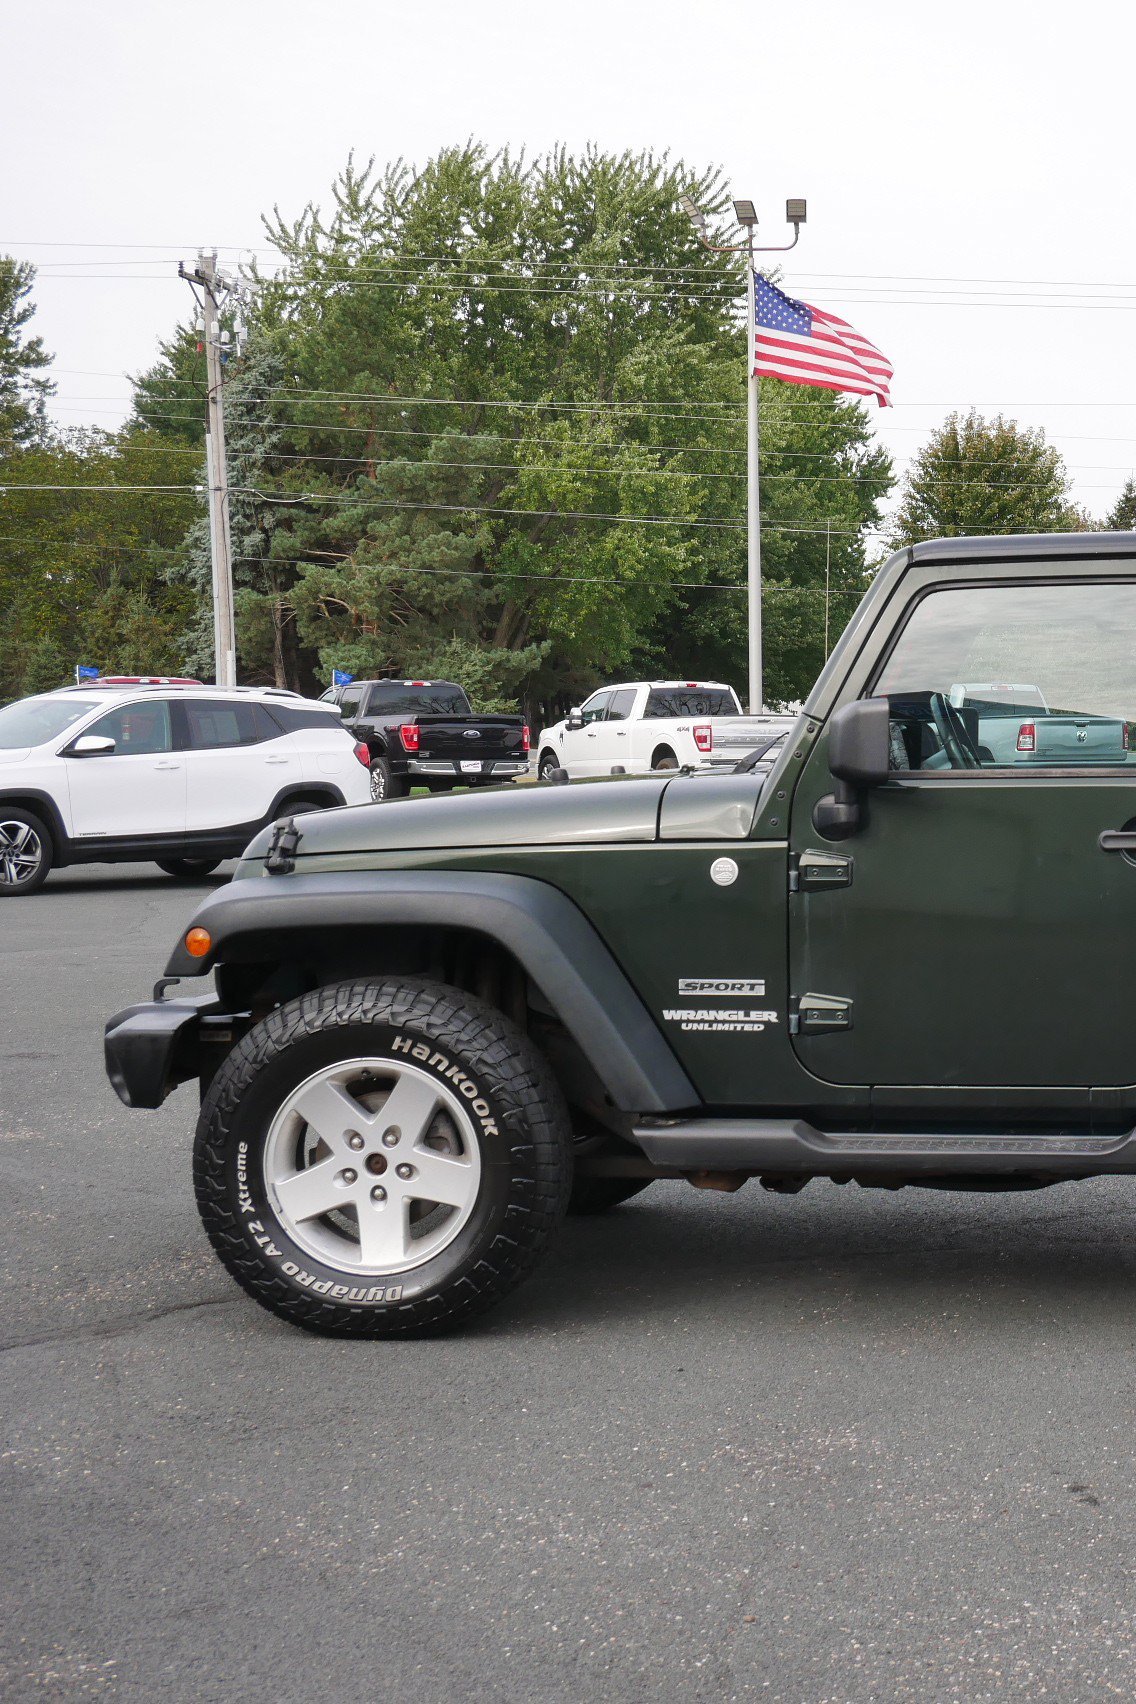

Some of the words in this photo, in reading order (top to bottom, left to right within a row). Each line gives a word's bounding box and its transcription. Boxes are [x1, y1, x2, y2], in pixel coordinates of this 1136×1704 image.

[679, 981, 765, 993] SPORT
[662, 1009, 779, 1022] WRANGLER
[681, 1022, 765, 1032] UNLIMITED
[238, 1140, 256, 1214] Xtreme
[248, 1220, 283, 1257] AT2
